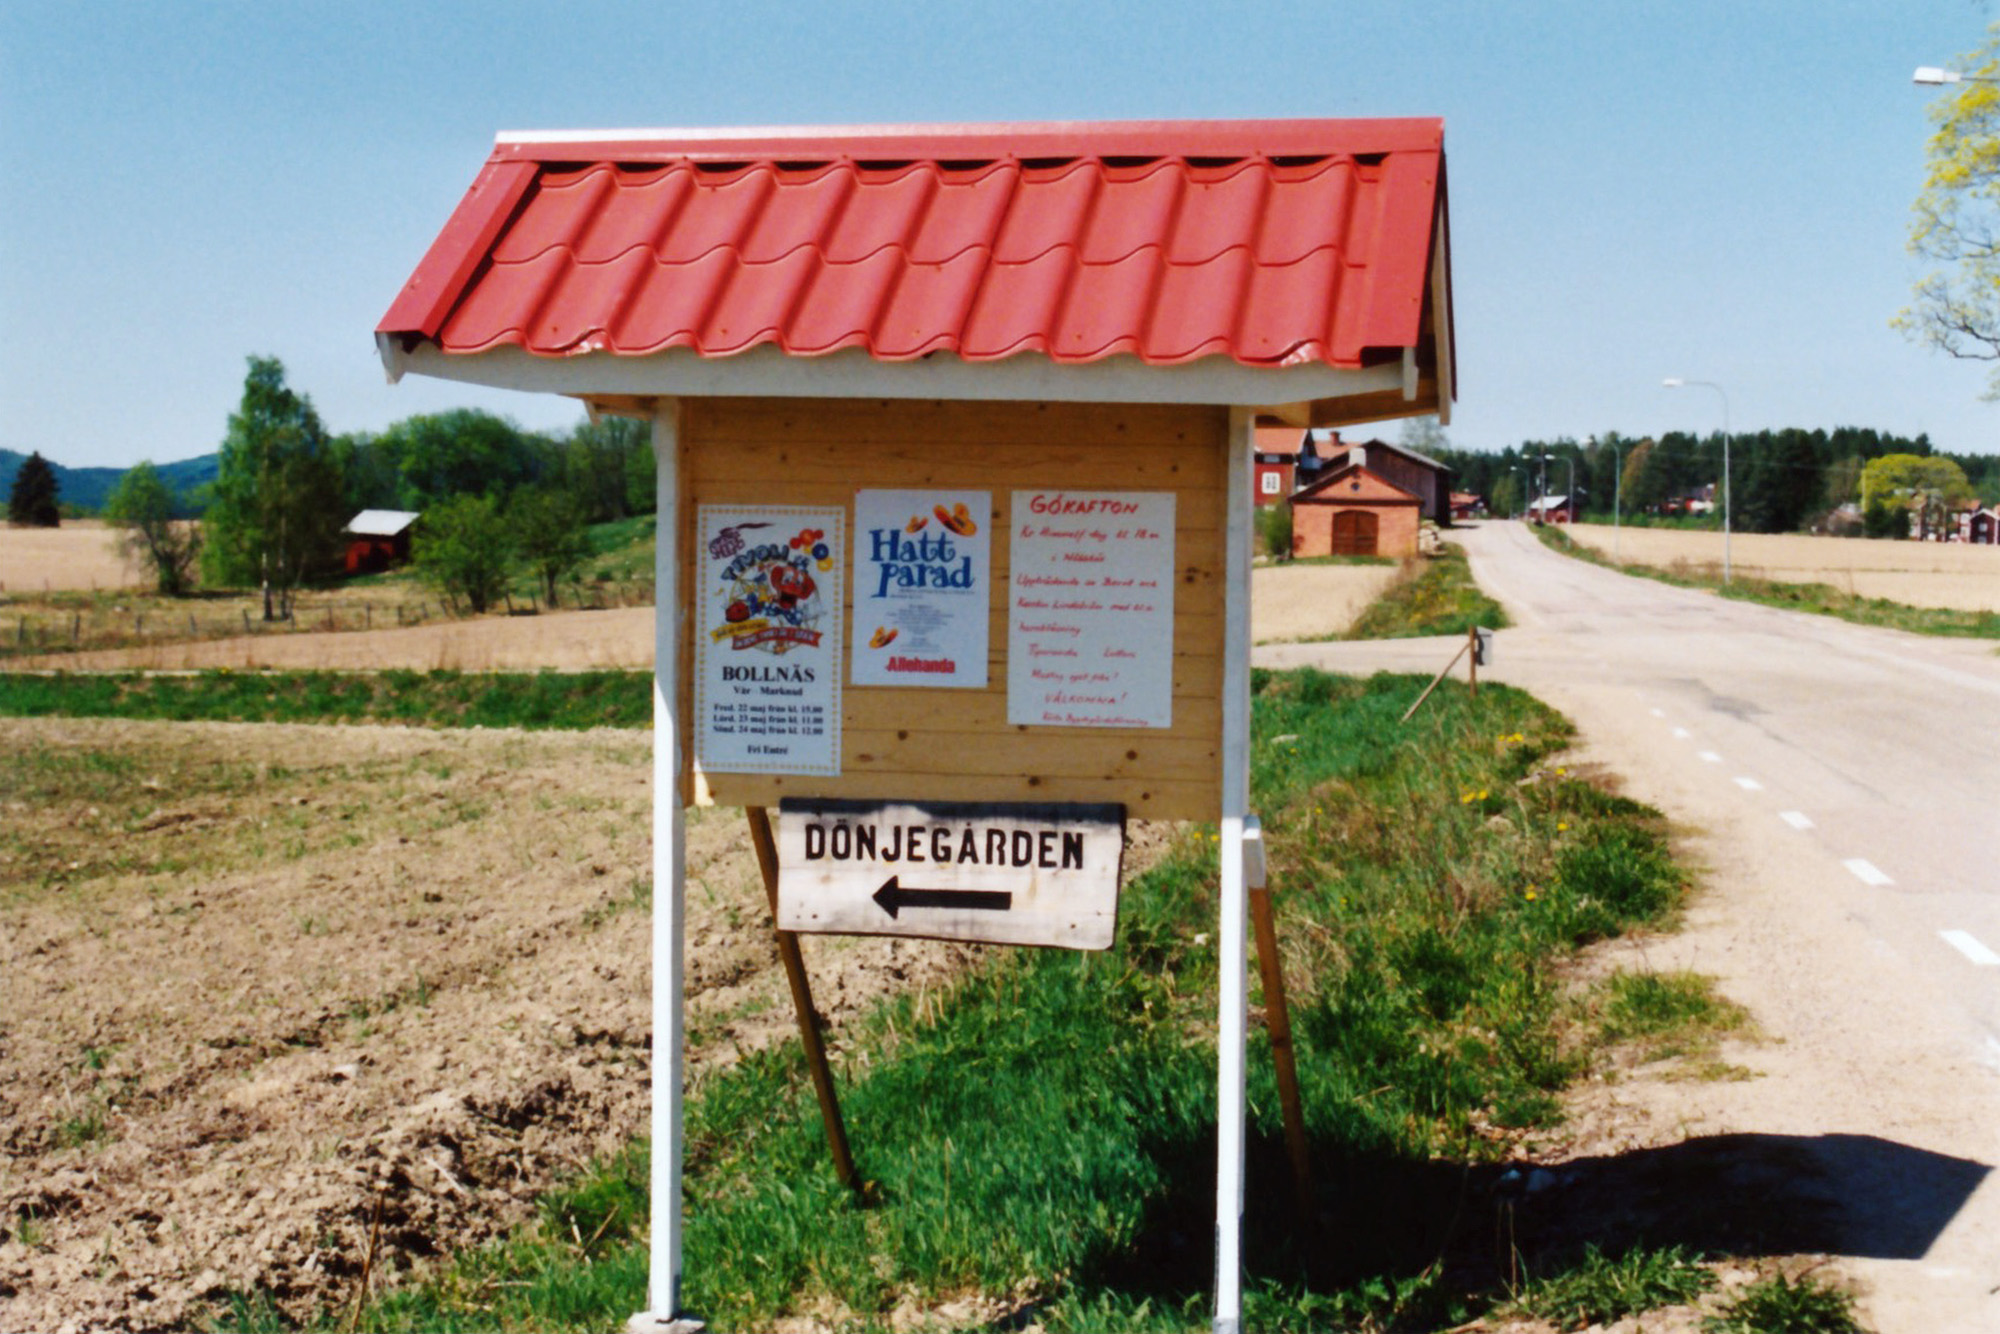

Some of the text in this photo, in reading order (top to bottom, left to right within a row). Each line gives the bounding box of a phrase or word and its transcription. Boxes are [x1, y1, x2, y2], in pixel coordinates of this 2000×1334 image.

[1030, 493, 1139, 515] GÖKAFTON
[869, 528, 956, 563] Hatt
[722, 664, 815, 682] BOLLNÄS
[760, 686, 803, 696] Marknad
[750, 705, 766, 715] maj
[750, 716, 766, 725] maj
[750, 726, 766, 735] maj
[805, 819, 1084, 870] DÖNJEGÅRDEN
